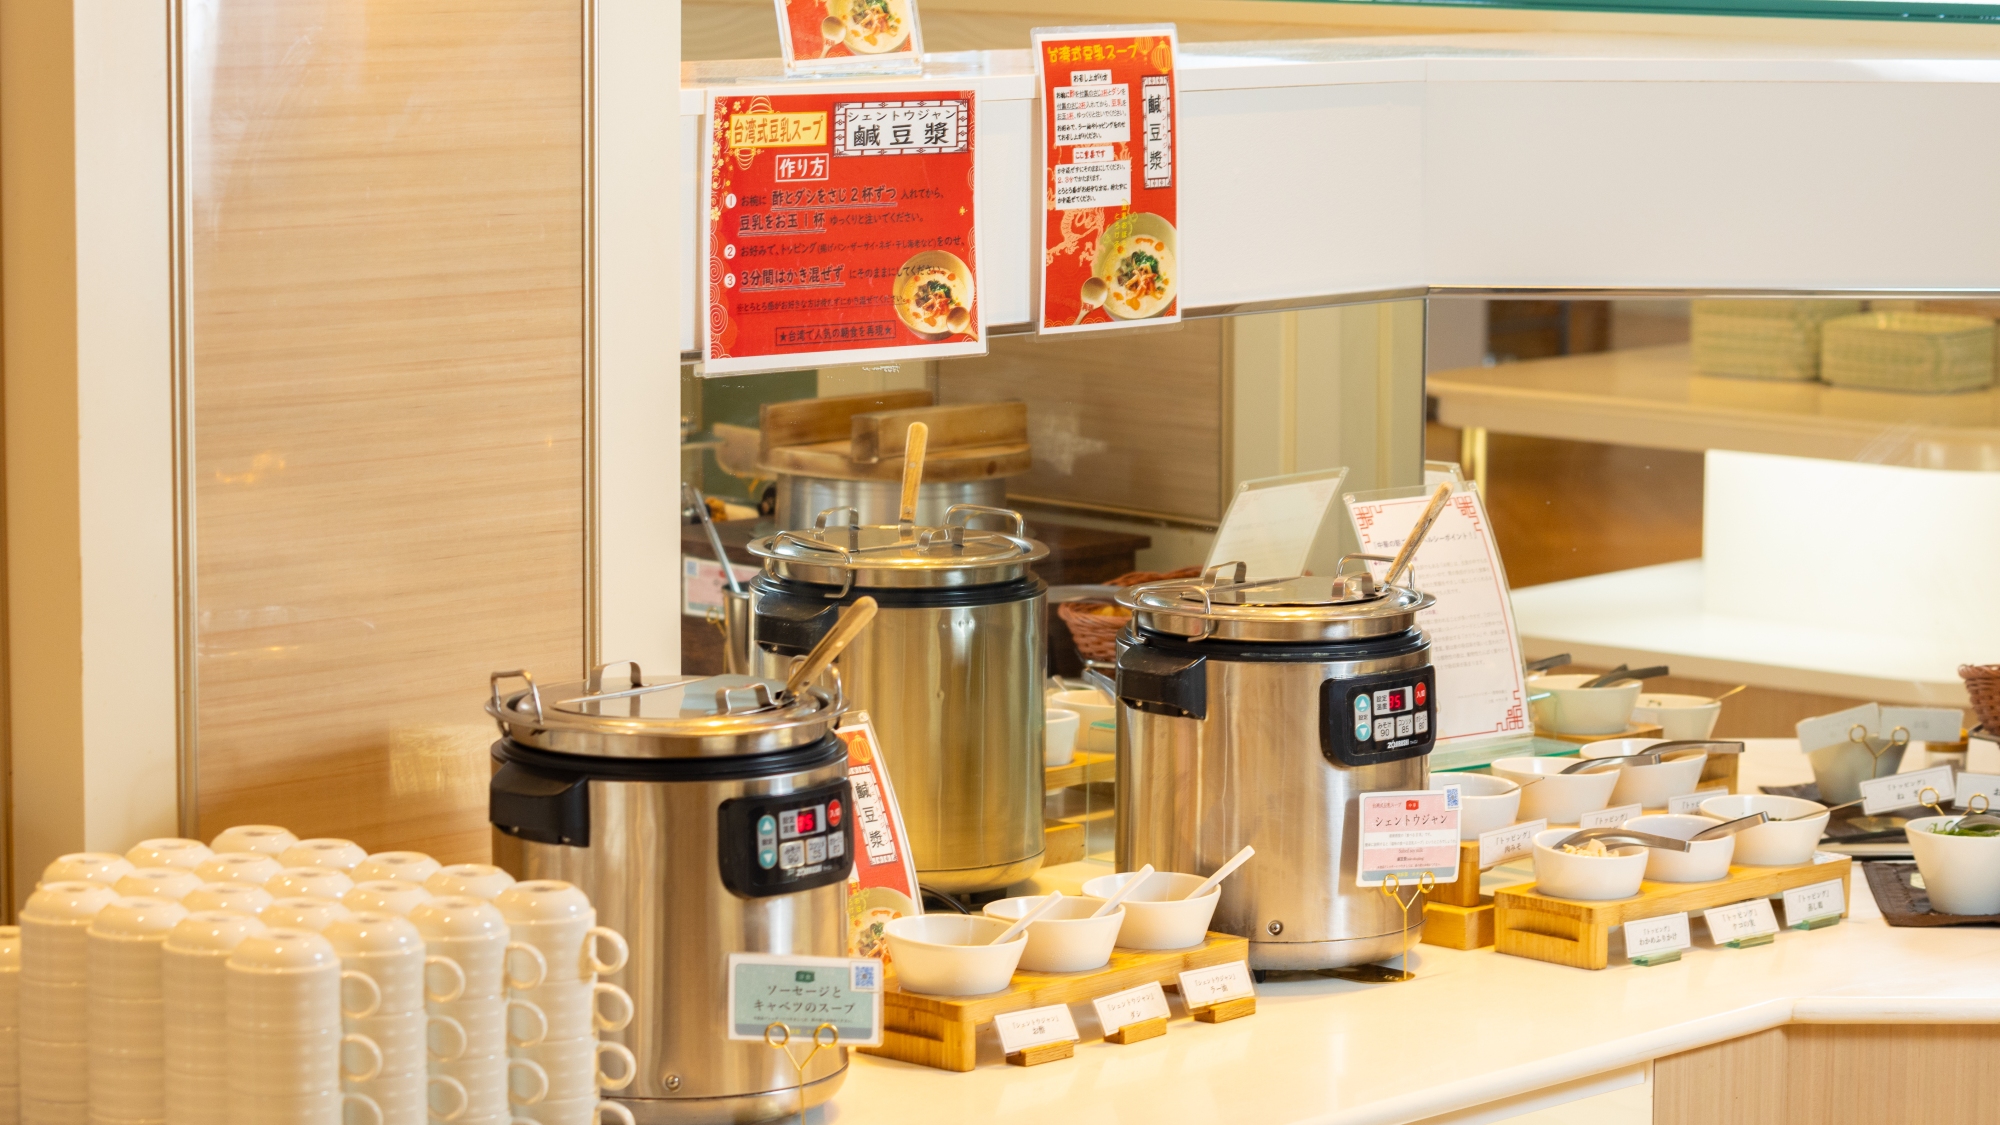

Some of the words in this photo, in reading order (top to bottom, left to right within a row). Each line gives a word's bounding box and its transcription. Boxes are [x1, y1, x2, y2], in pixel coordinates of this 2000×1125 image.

[1047, 42, 1139, 63] 台湾式豆乳スープ
[847, 108, 957, 122] シェントウジャン
[733, 115, 824, 144] 台湾式豆乳スープ
[780, 158, 826, 178] 作り方
[740, 264, 844, 286] 3分間はかき混ぜず
[1402, 726, 1409, 734] 85
[1375, 814, 1448, 827] シェントウジャン
[768, 985, 842, 998] ソーセージと
[754, 999, 856, 1014] キャベツのスープ
